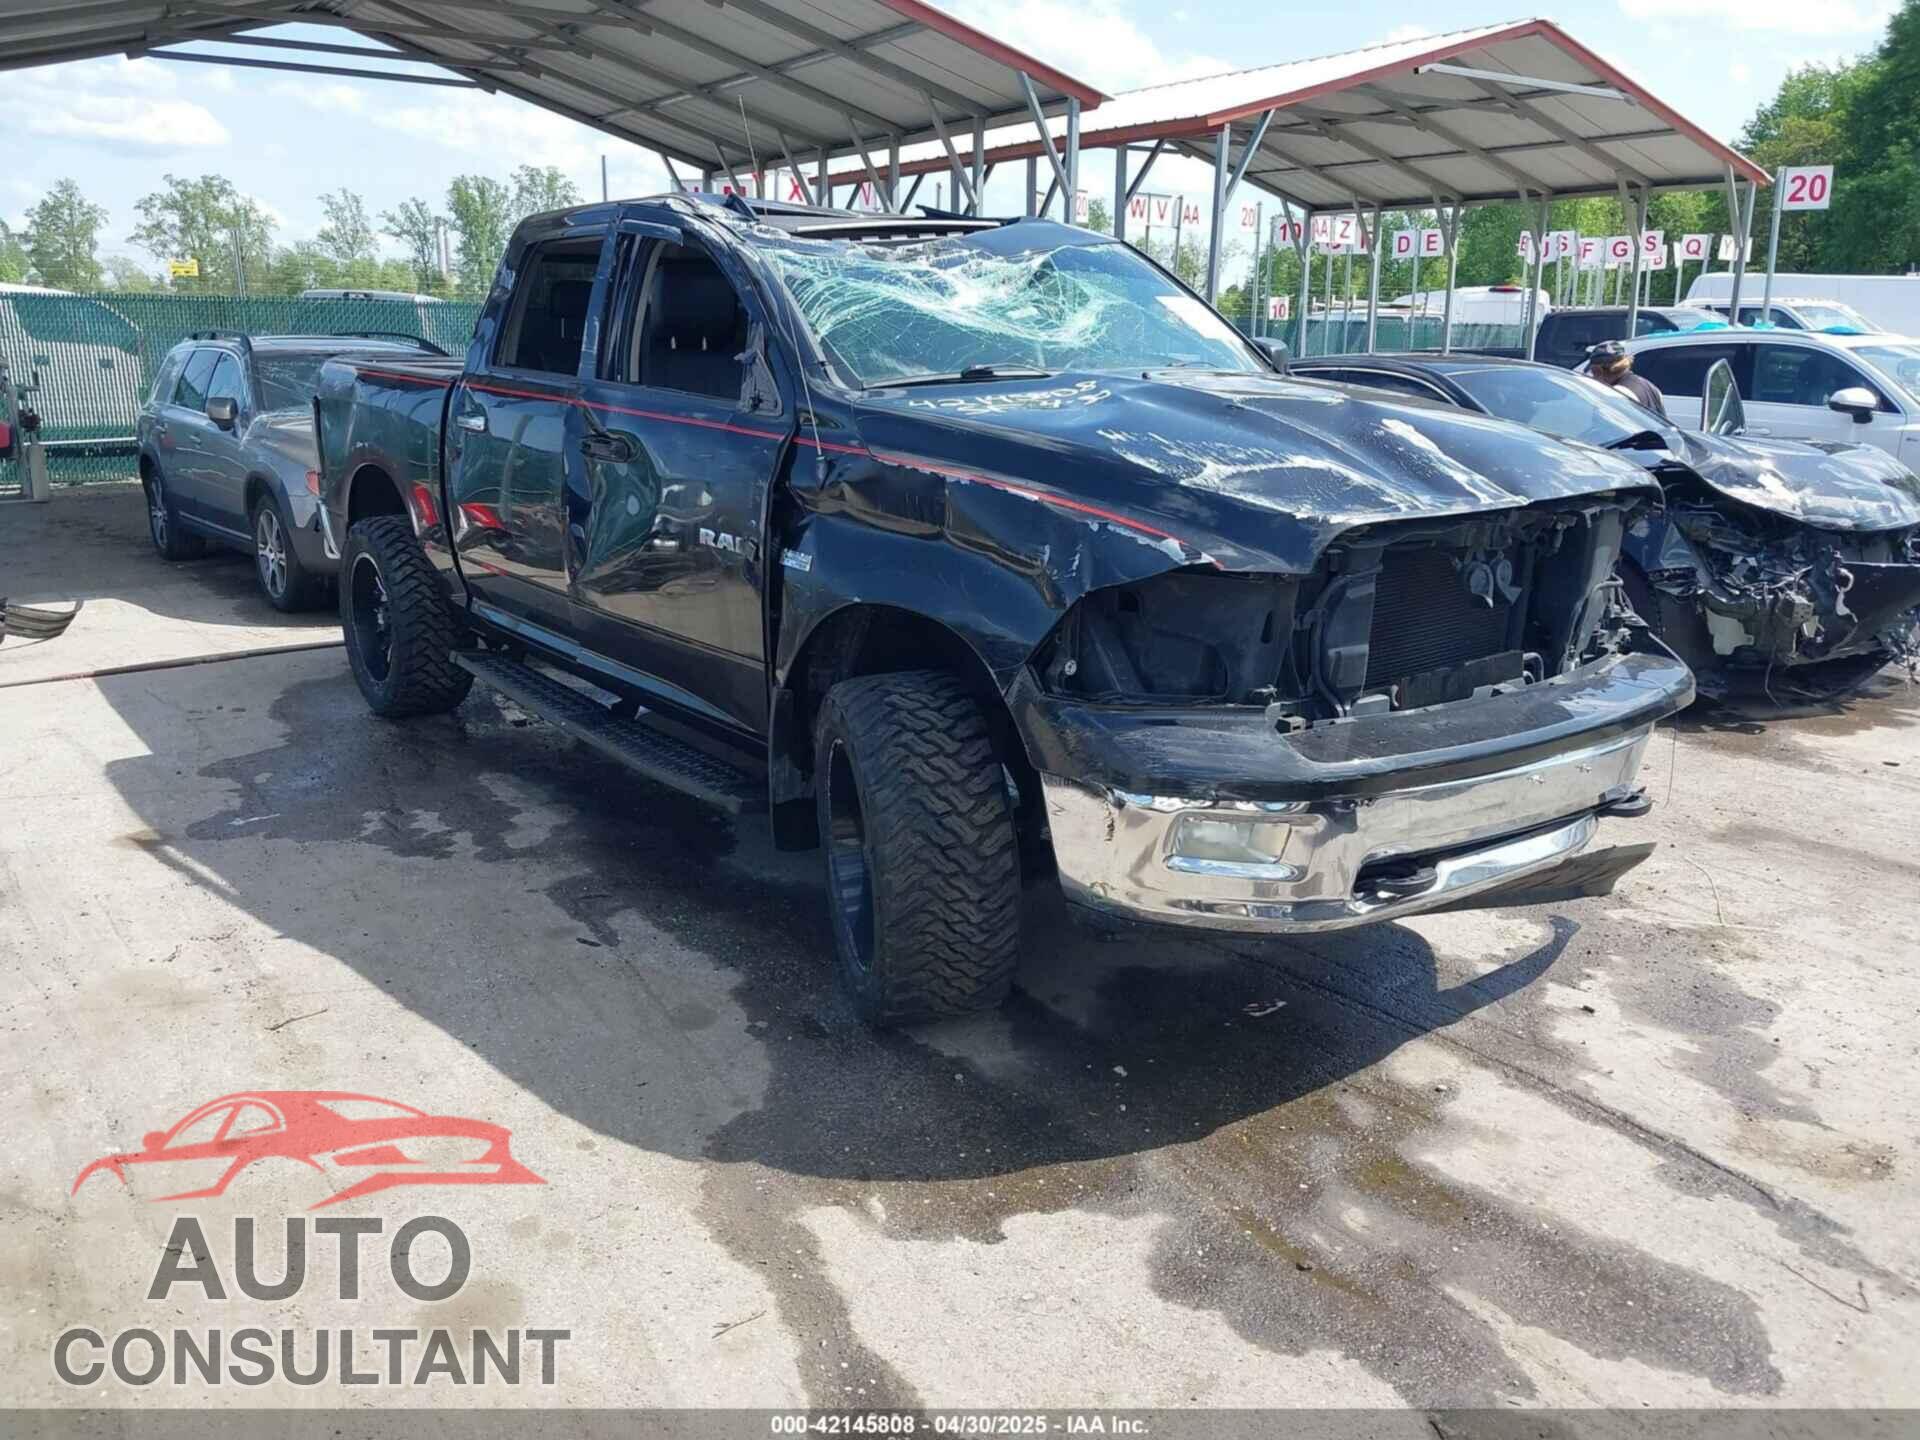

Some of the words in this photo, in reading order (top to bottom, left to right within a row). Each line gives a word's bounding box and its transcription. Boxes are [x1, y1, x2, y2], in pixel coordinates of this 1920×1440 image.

[788, 176, 804, 202] X
[1787, 174, 1827, 202] 20
[1130, 199, 1147, 218] W
[1157, 200, 1168, 220] V
[1183, 204, 1200, 224] AA
[1241, 207, 1255, 226] 20
[1340, 220, 1350, 239] Z
[1397, 235, 1410, 253] D
[1426, 233, 1438, 251] E
[1557, 235, 1568, 252] S
[1582, 242, 1594, 258] F
[1612, 240, 1628, 257] G
[1645, 235, 1656, 252] S
[1685, 239, 1701, 256] Q
[1272, 303, 1286, 318] 10
